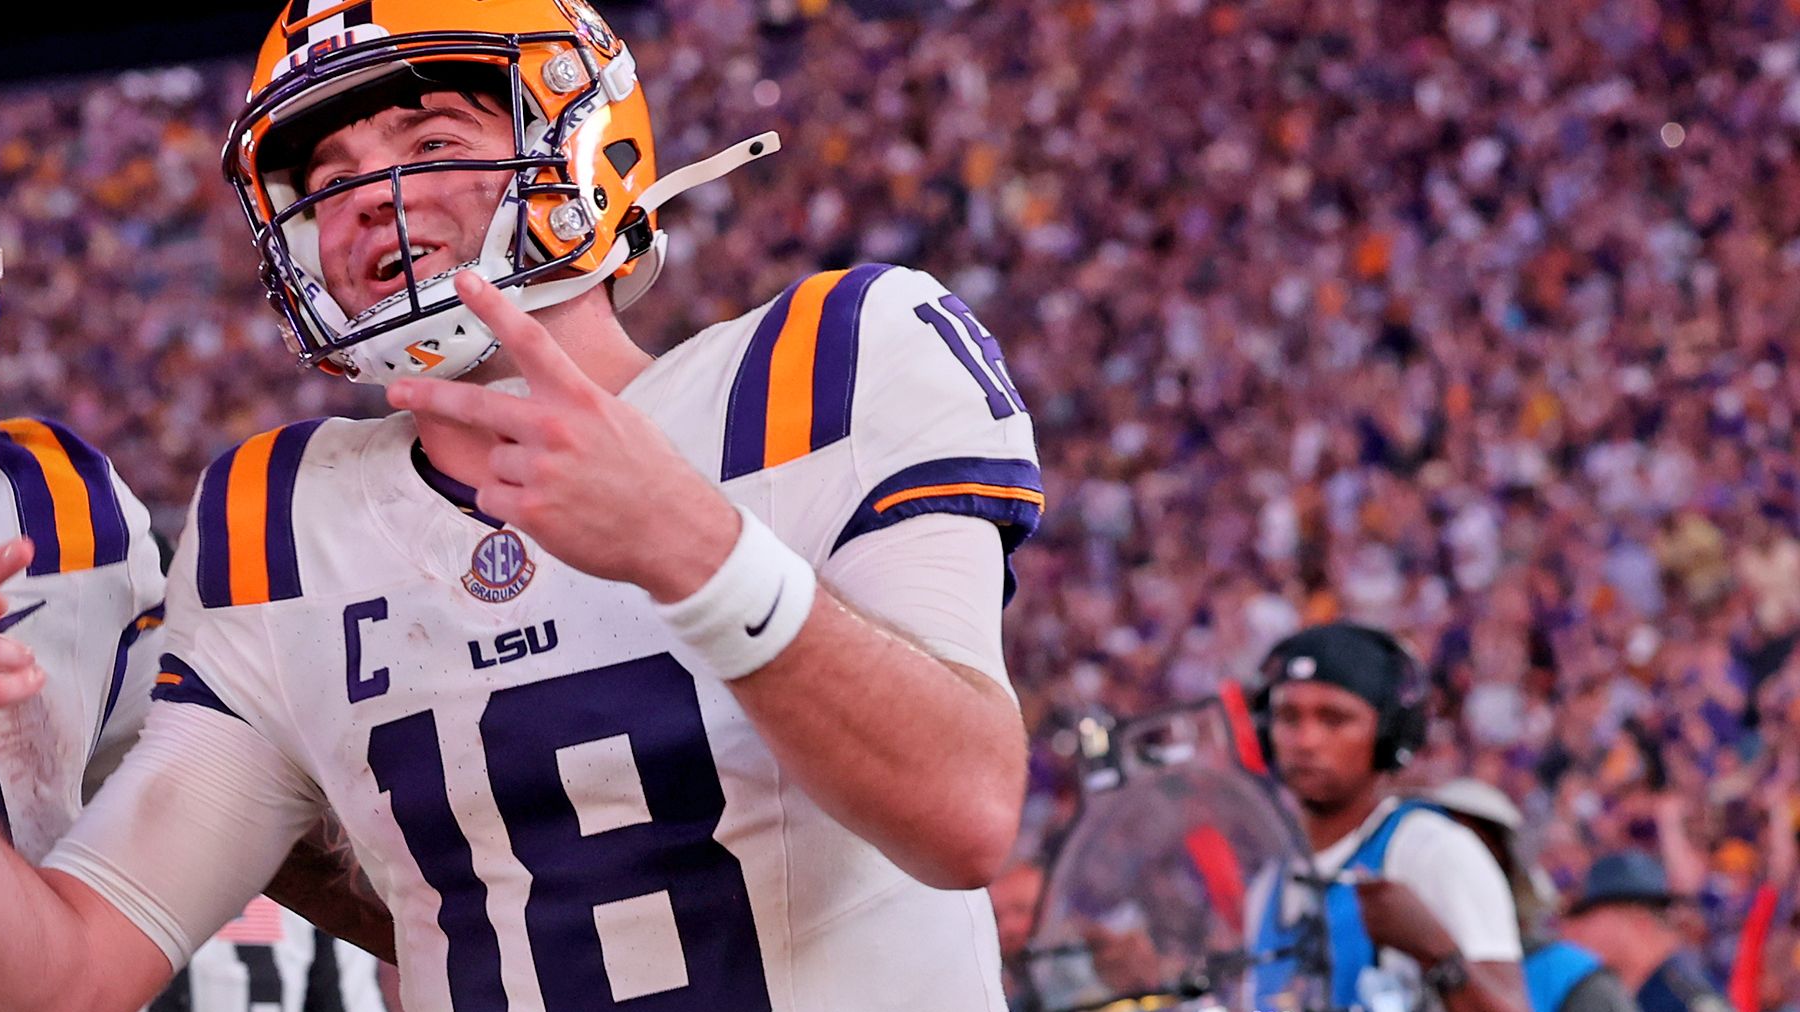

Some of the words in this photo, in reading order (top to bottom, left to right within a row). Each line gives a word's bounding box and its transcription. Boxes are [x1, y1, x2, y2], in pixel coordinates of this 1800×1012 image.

[913, 294, 1028, 420] 18
[477, 534, 522, 584] SEC
[344, 597, 390, 704] C
[468, 619, 559, 669] LSU
